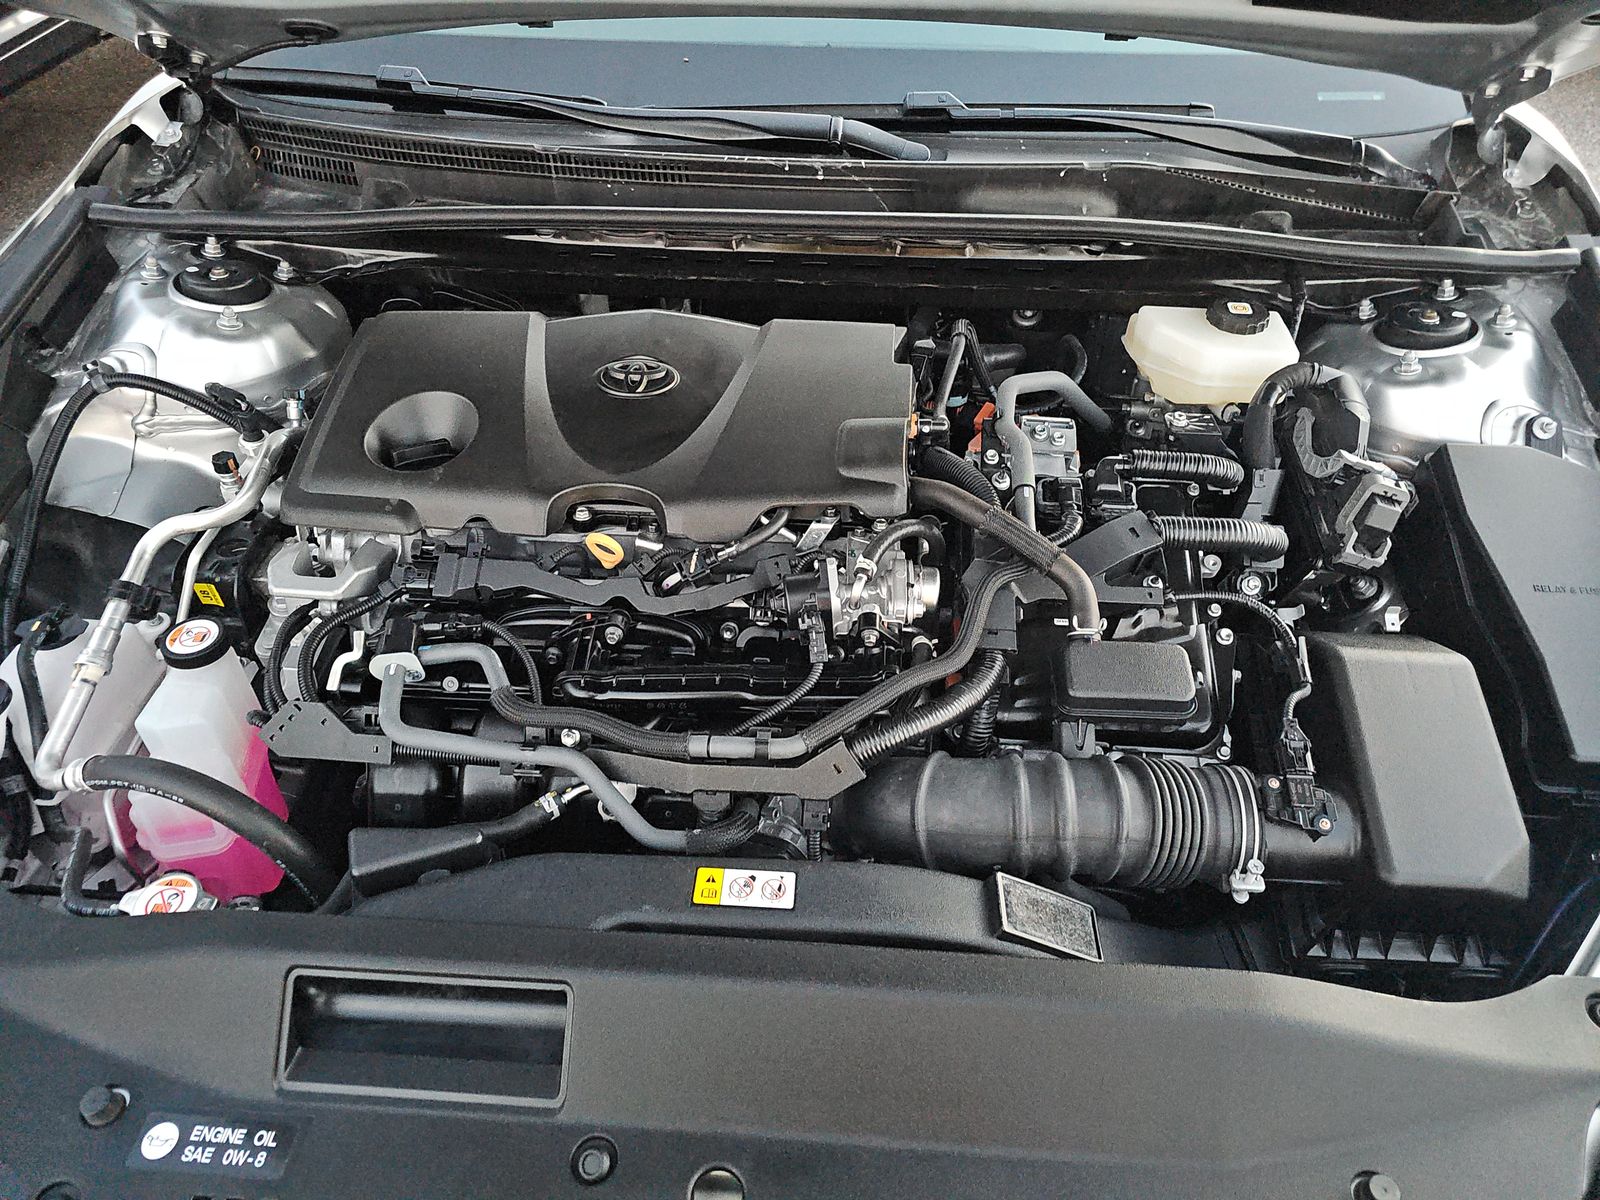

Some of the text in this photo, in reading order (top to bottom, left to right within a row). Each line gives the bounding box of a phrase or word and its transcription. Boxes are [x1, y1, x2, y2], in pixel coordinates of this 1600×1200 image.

[1532, 584, 1566, 593] RELAY
[189, 1125, 277, 1148] ENGINE OIL
[181, 1146, 267, 1168] SAE 0W-8
